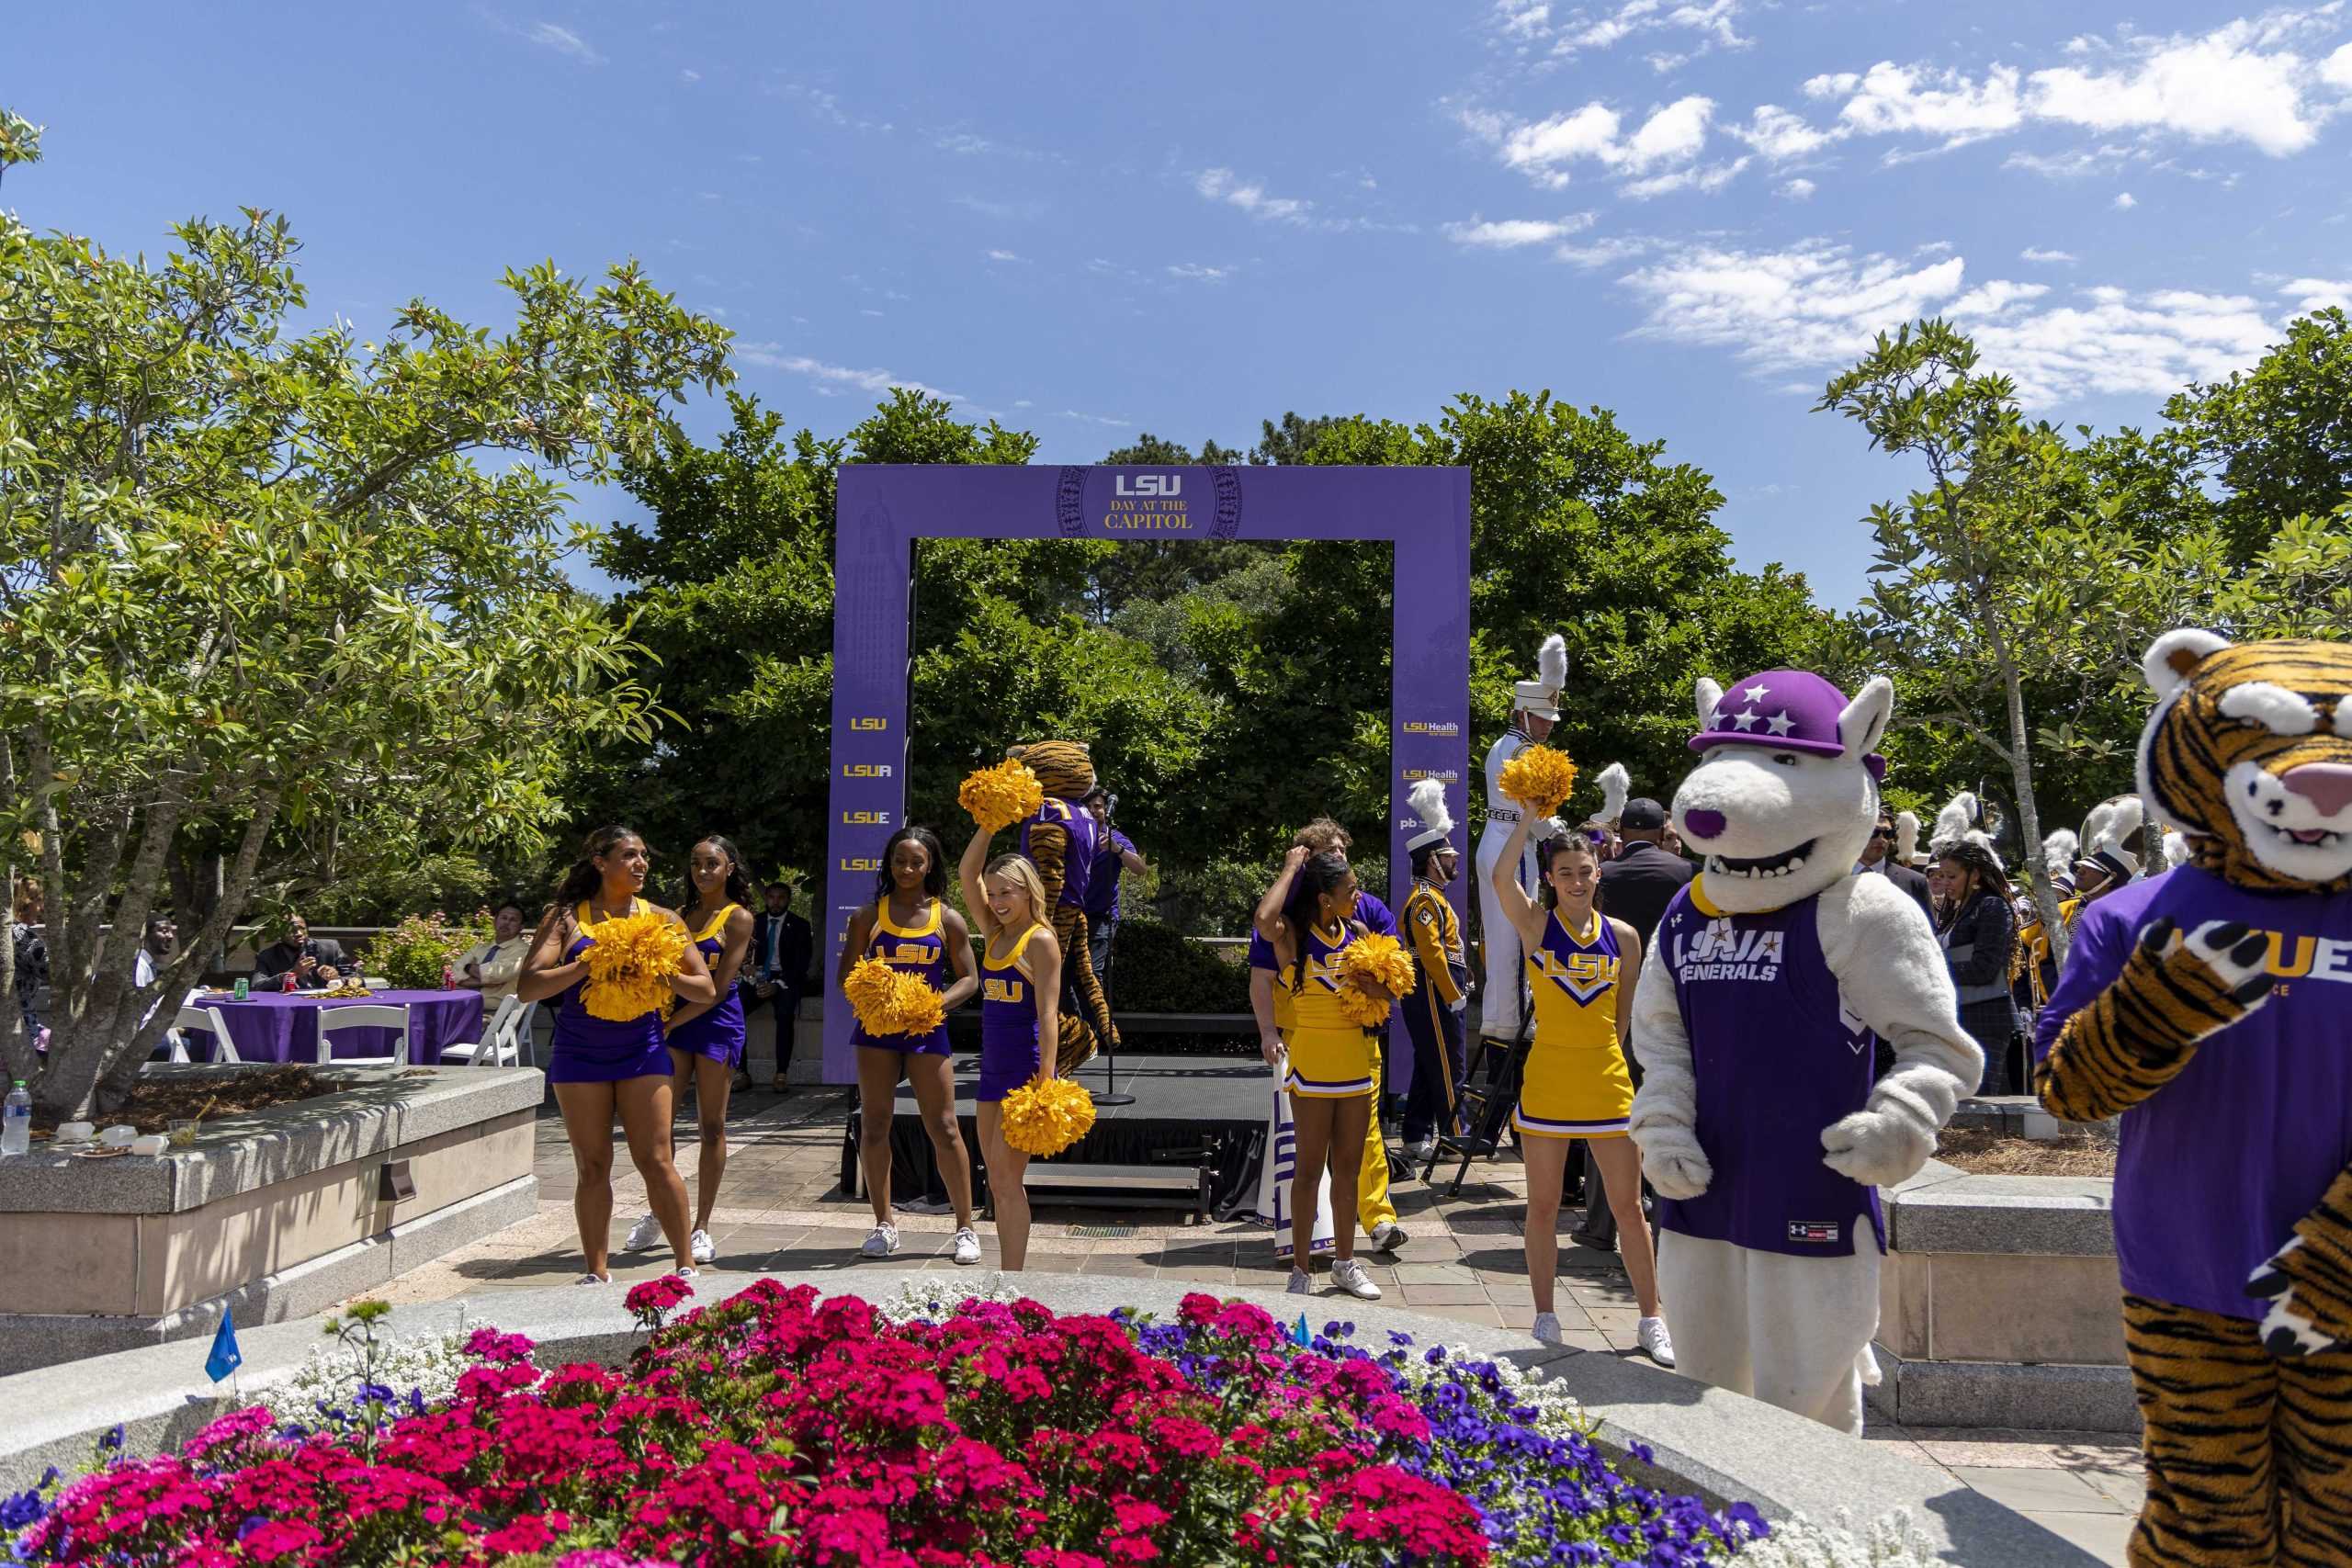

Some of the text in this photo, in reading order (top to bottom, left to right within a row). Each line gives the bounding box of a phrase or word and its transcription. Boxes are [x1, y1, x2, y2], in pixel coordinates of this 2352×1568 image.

[1115, 475, 1182, 496] LSU
[1110, 500, 1188, 511] DAY AT THE
[1103, 513, 1193, 530] CAPITOL
[851, 717, 887, 730] LSU
[1403, 722, 1459, 732] LSU Health
[842, 764, 892, 777] LSUA
[1402, 770, 1458, 779] LSU Health
[842, 811, 890, 824] LSUE
[876, 943, 941, 964] LSU
[1305, 953, 1348, 978] LS
[1544, 950, 1622, 983] LSU
[982, 978, 1023, 1003] SU
